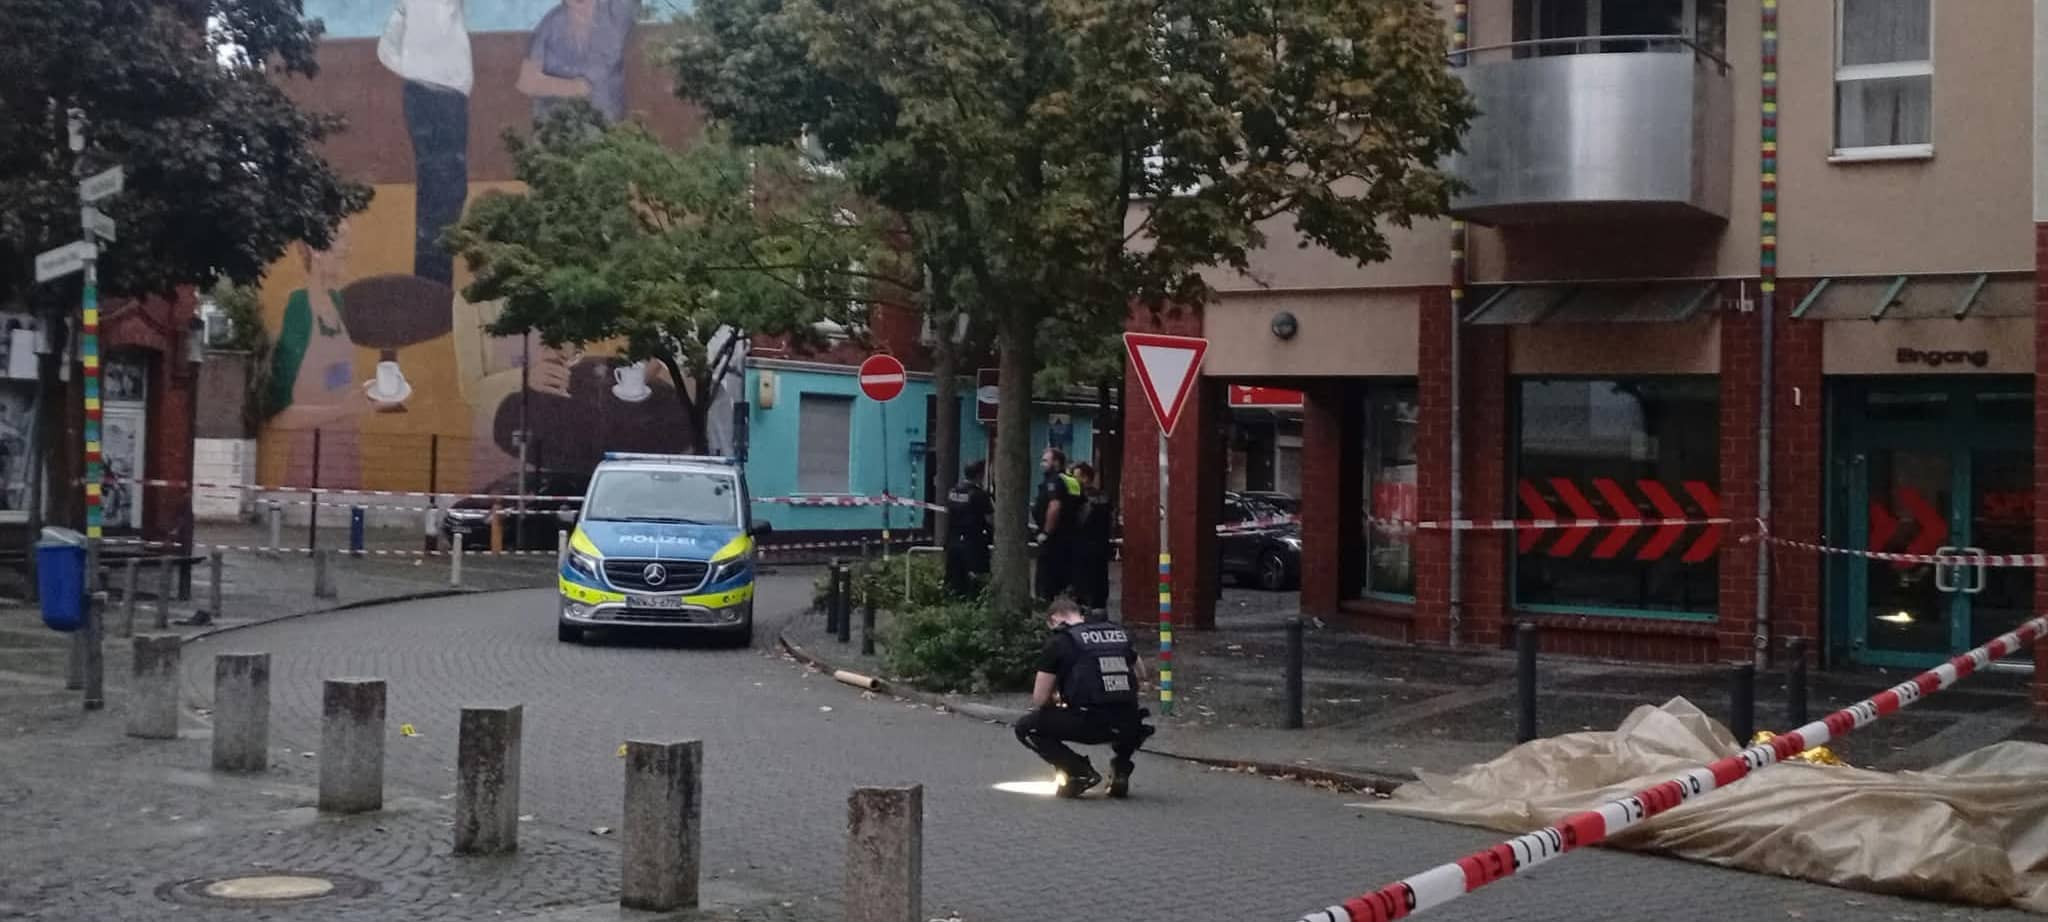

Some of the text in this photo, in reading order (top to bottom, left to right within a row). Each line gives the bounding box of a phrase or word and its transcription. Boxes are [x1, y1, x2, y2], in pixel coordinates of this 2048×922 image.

[1896, 347, 1988, 367] Eingang
[619, 534, 697, 546] POLIZEI
[1080, 629, 1128, 644] POLIZEI
